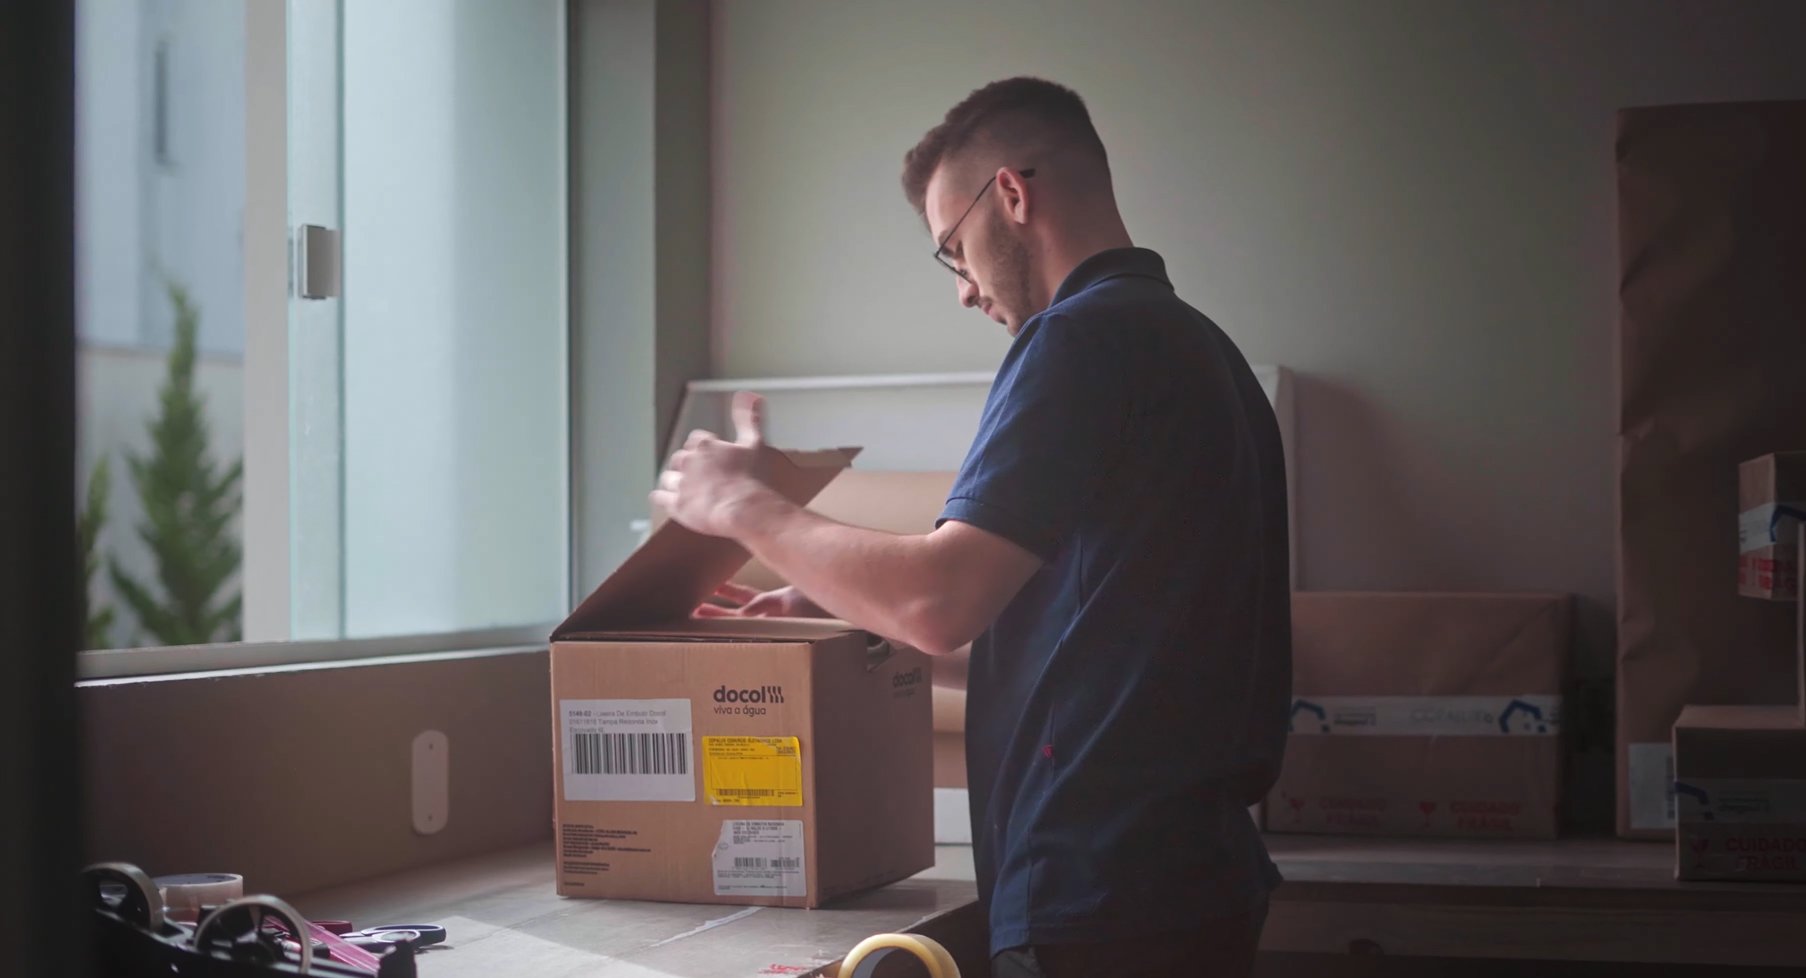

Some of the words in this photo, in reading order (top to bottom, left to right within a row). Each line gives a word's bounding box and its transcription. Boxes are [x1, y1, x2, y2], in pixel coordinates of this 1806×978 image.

[713, 685, 767, 703] docol
[713, 706, 733, 714] viva
[734, 707, 741, 715] a
[742, 704, 767, 718] água
[1726, 838, 1806, 852] CUIDADO
